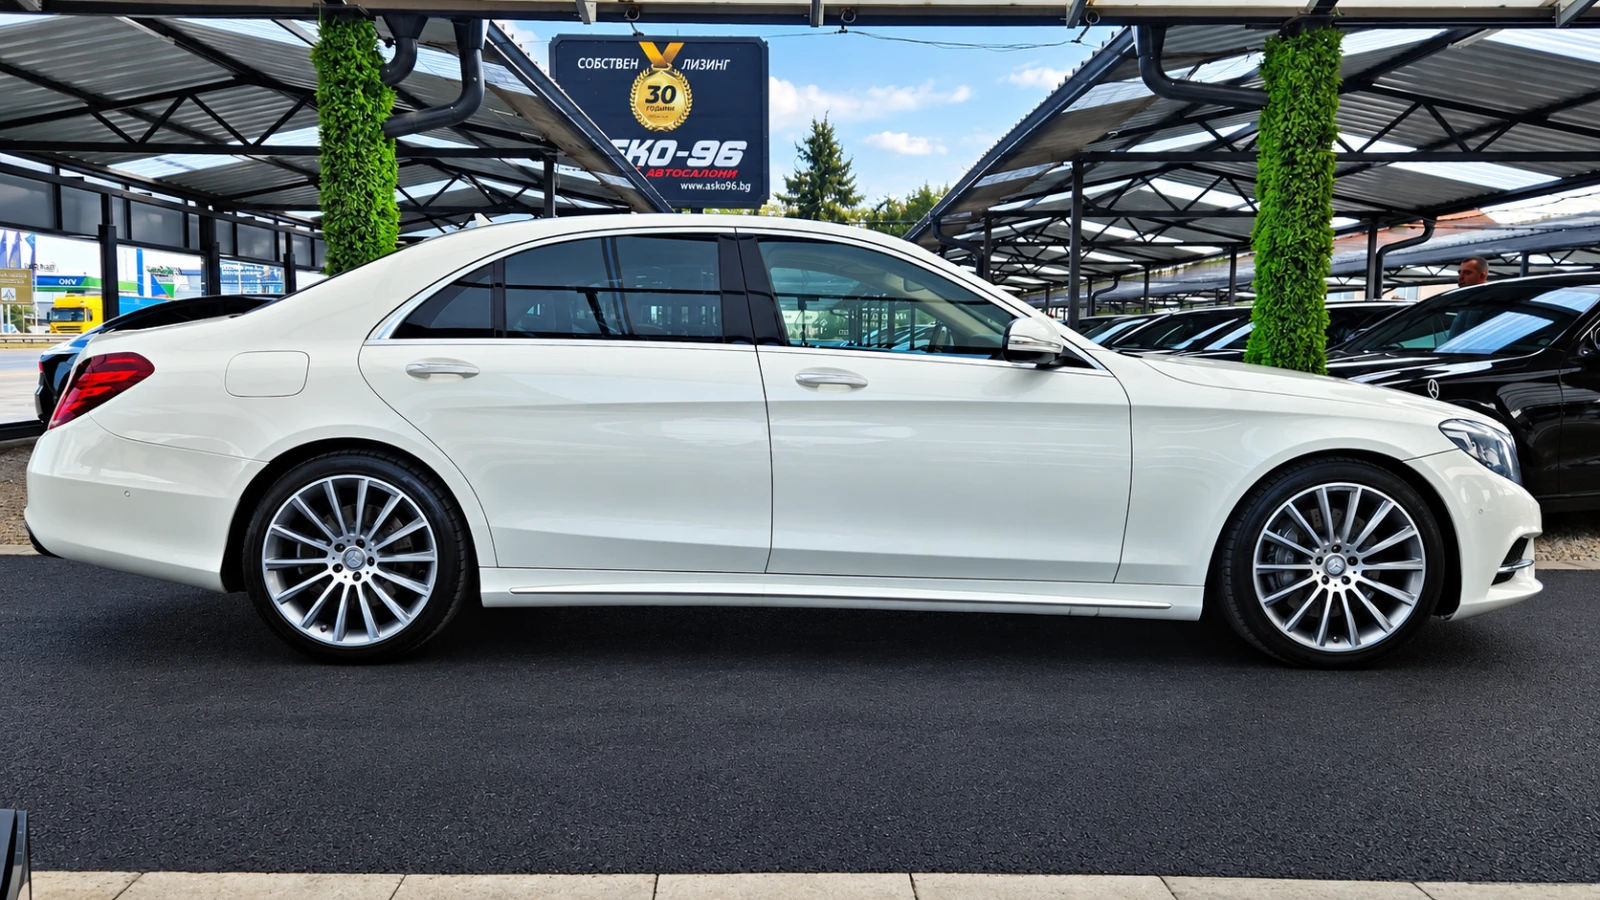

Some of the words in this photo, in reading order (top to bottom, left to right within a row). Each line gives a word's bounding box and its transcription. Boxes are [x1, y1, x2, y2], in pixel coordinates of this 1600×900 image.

[577, 57, 639, 70] СОБСТВЕН
[681, 58, 731, 71] ЛИЗИНГ
[645, 85, 677, 104] 30
[610, 139, 748, 167] KO-96
[645, 168, 739, 179] АВТОСАЛОНИ
[680, 181, 751, 192] www.asko96.bg
